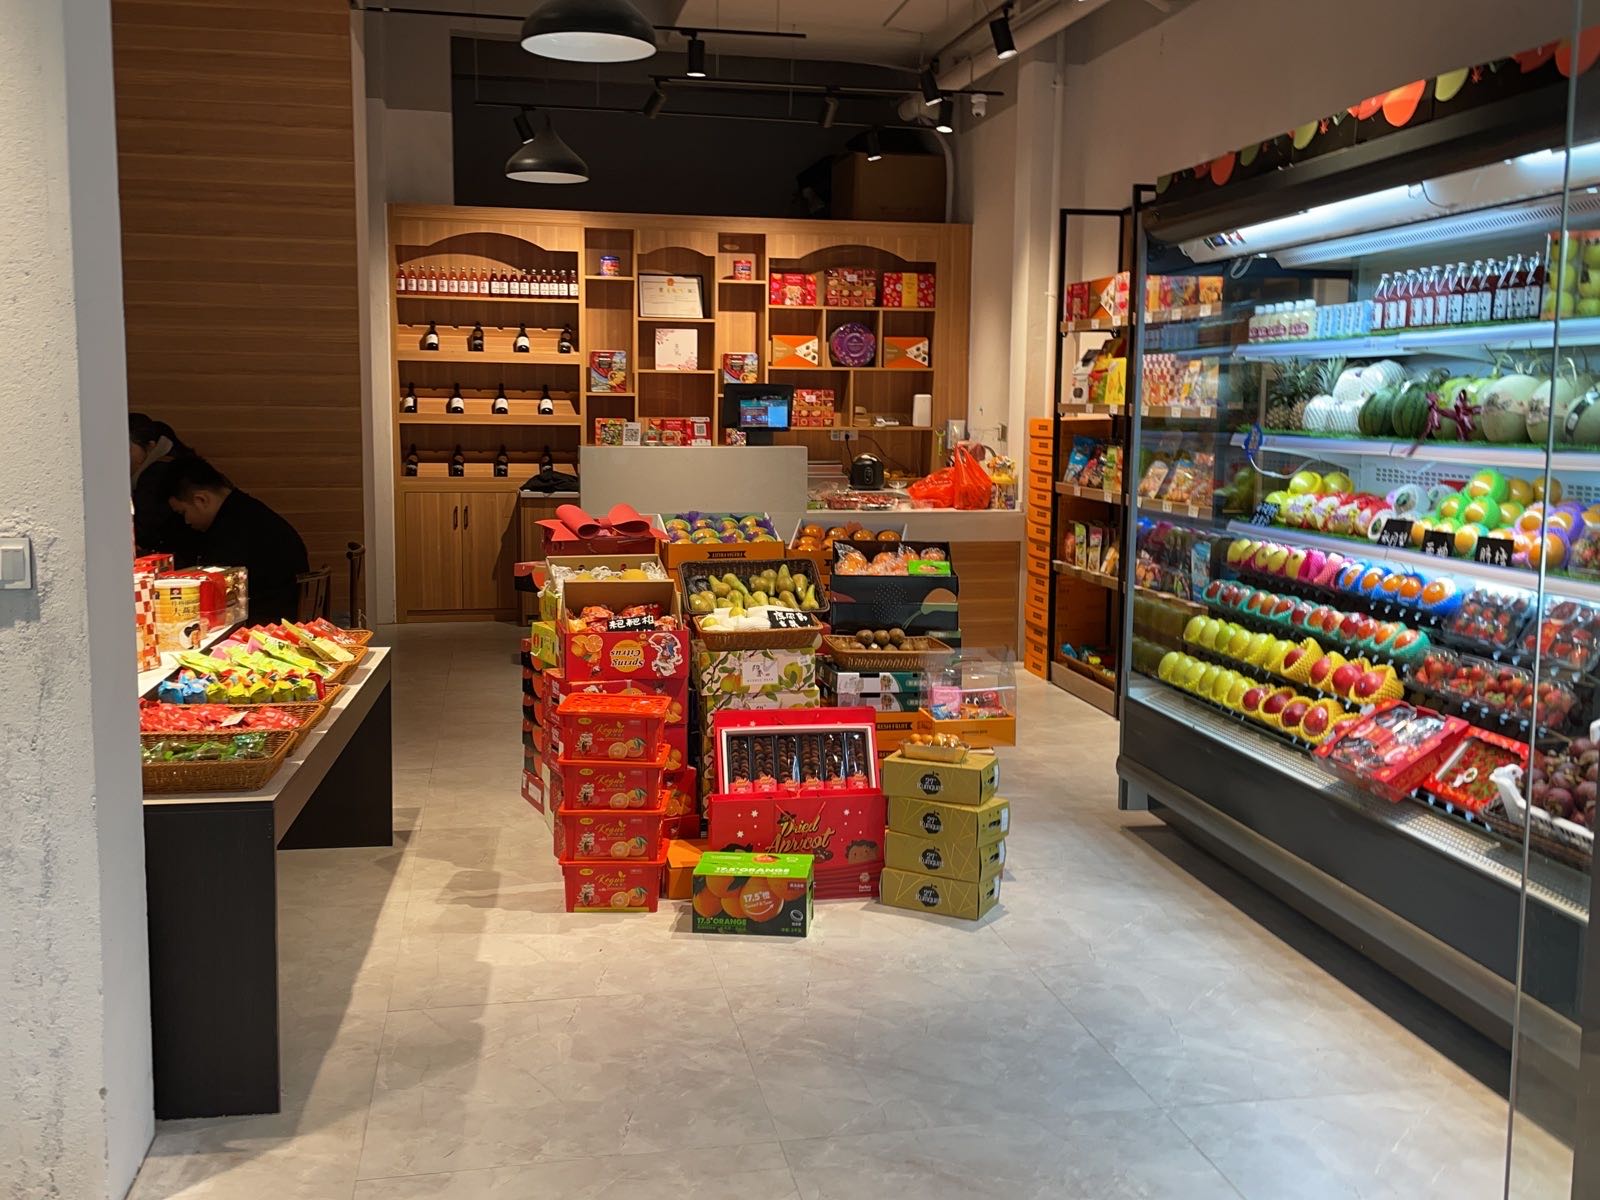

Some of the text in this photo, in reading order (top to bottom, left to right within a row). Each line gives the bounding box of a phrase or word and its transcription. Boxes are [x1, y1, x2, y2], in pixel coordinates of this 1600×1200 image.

[608, 614, 655, 630] 粑粑柑
[610, 649, 641, 658] Citrus
[611, 658, 644, 667] Spring
[780, 815, 821, 837] Dried
[765, 827, 836, 853] Apricot
